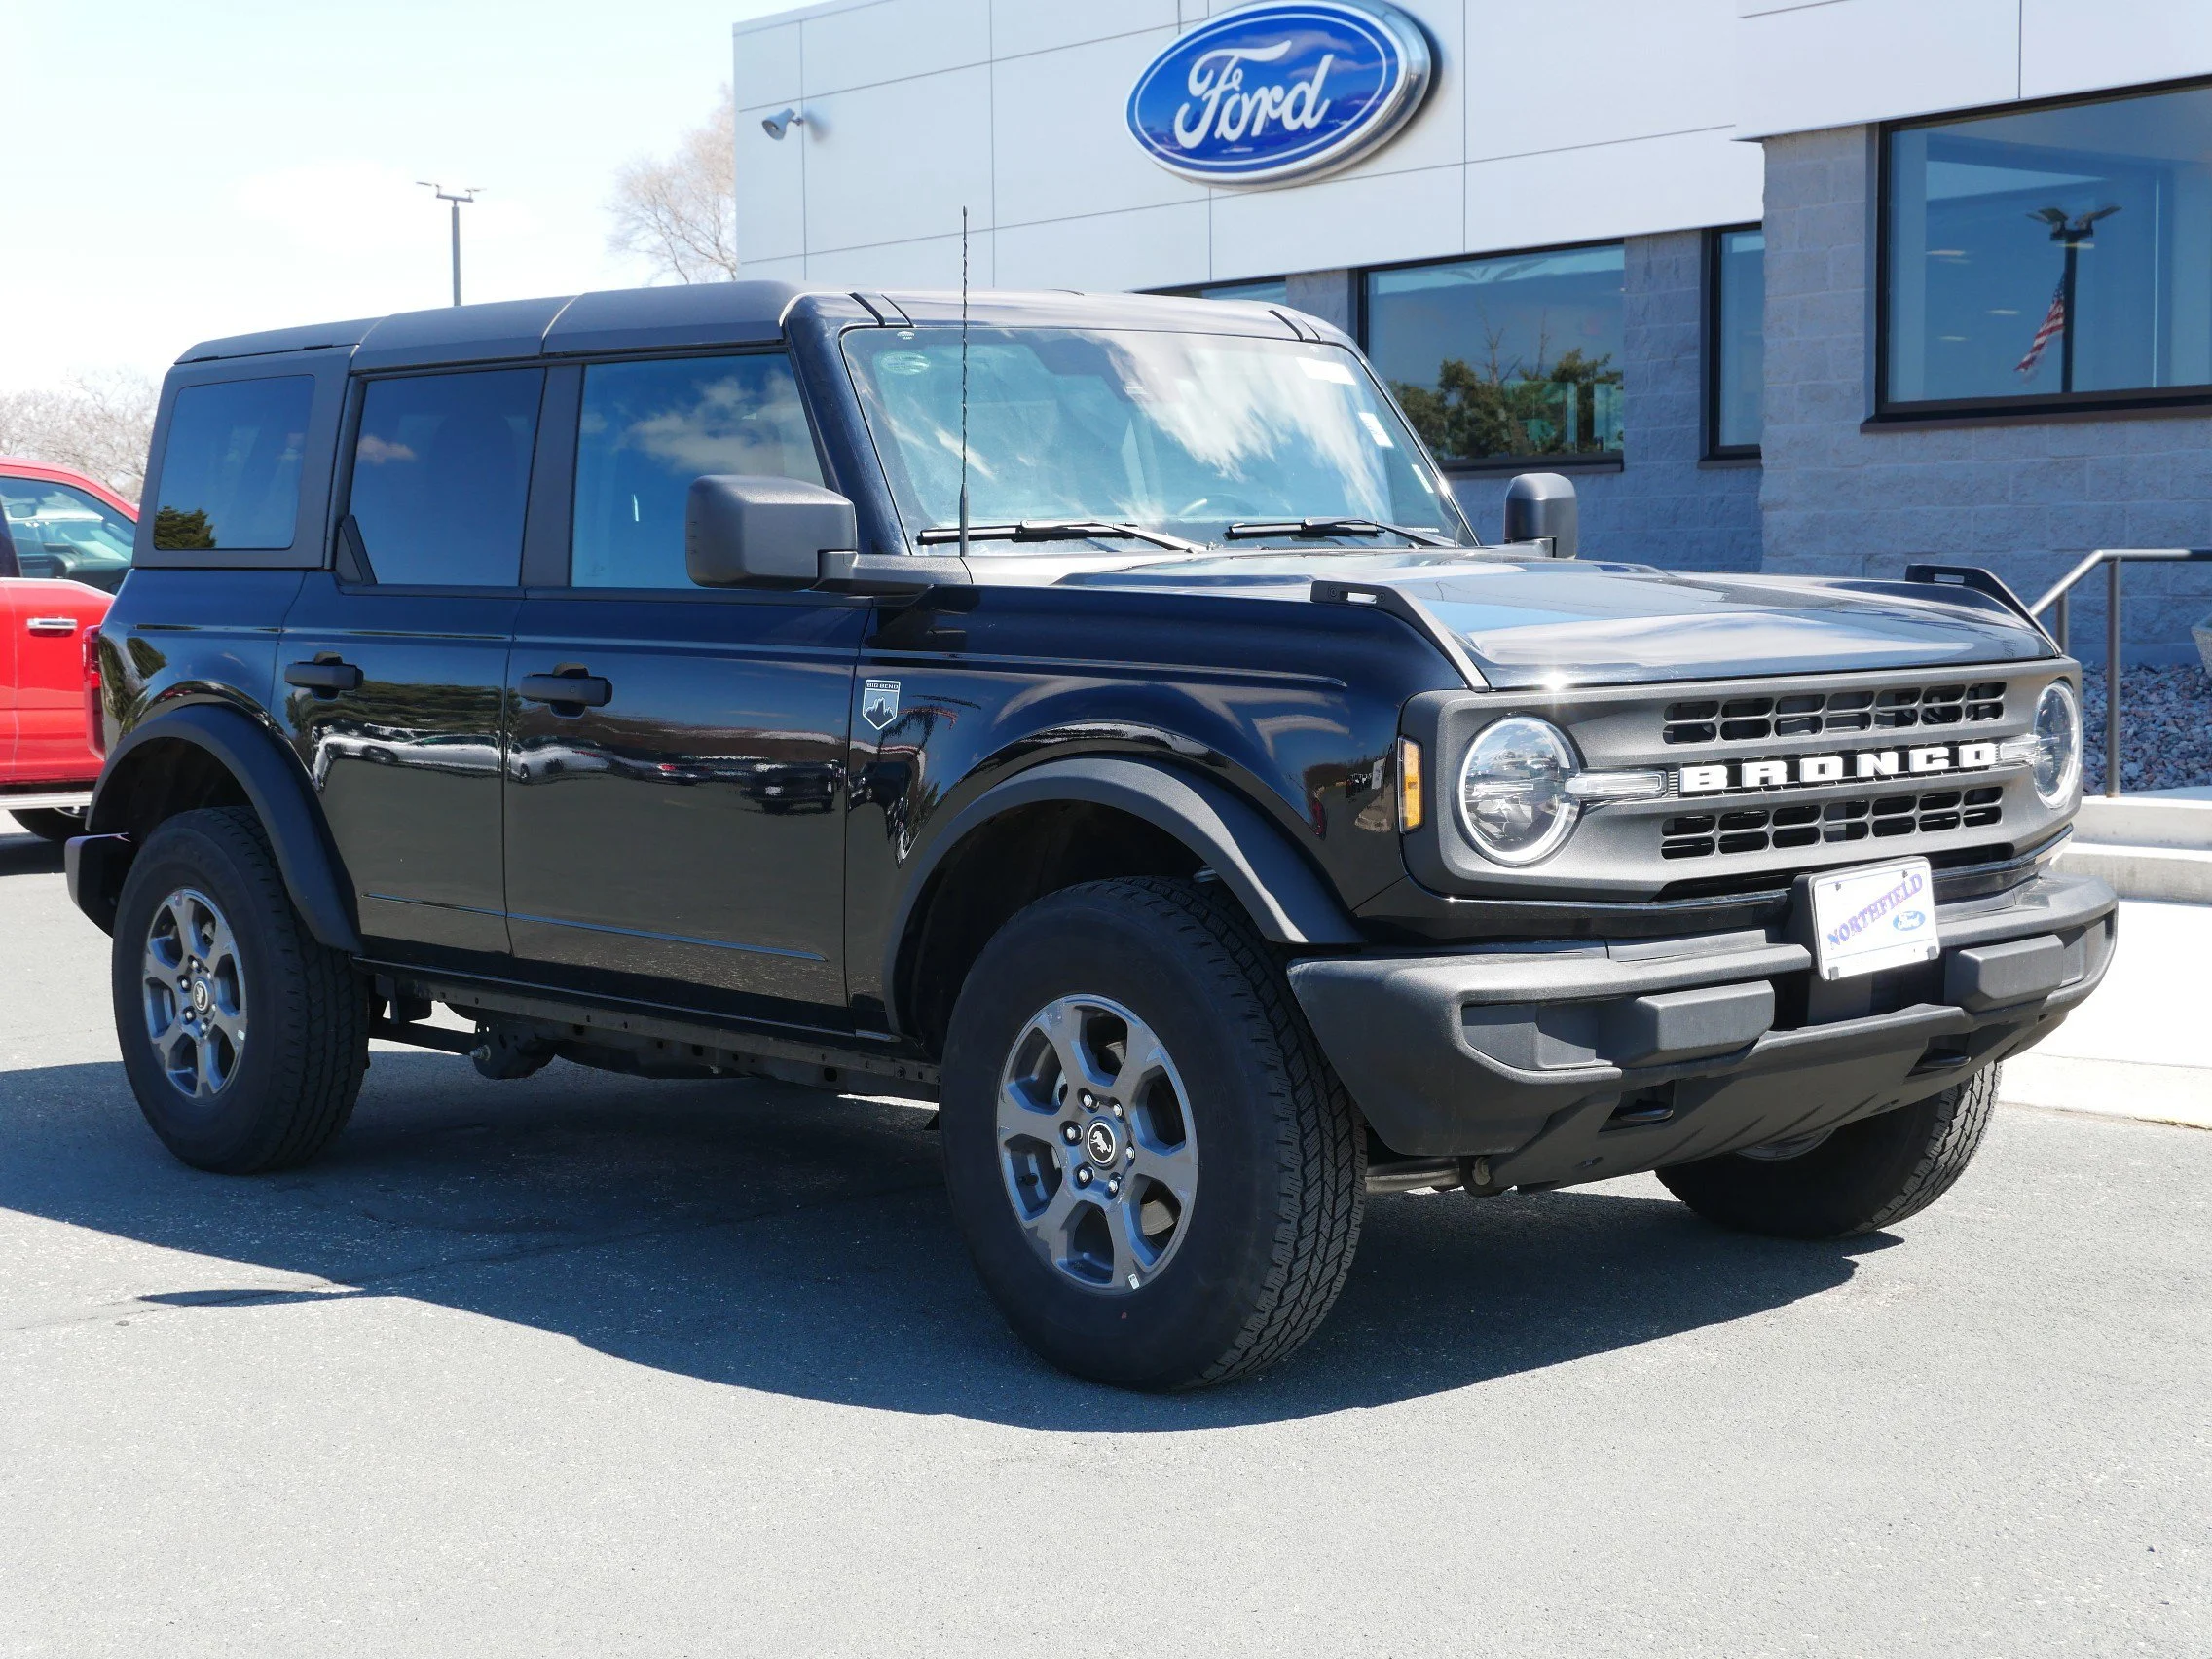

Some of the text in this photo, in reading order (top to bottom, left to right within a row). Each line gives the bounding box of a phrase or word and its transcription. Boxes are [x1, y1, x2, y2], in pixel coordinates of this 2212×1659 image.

[1174, 40, 1334, 149] Ford
[1677, 742, 1997, 793] BRONCO
[1827, 873, 1923, 950] NORTHFIELD
